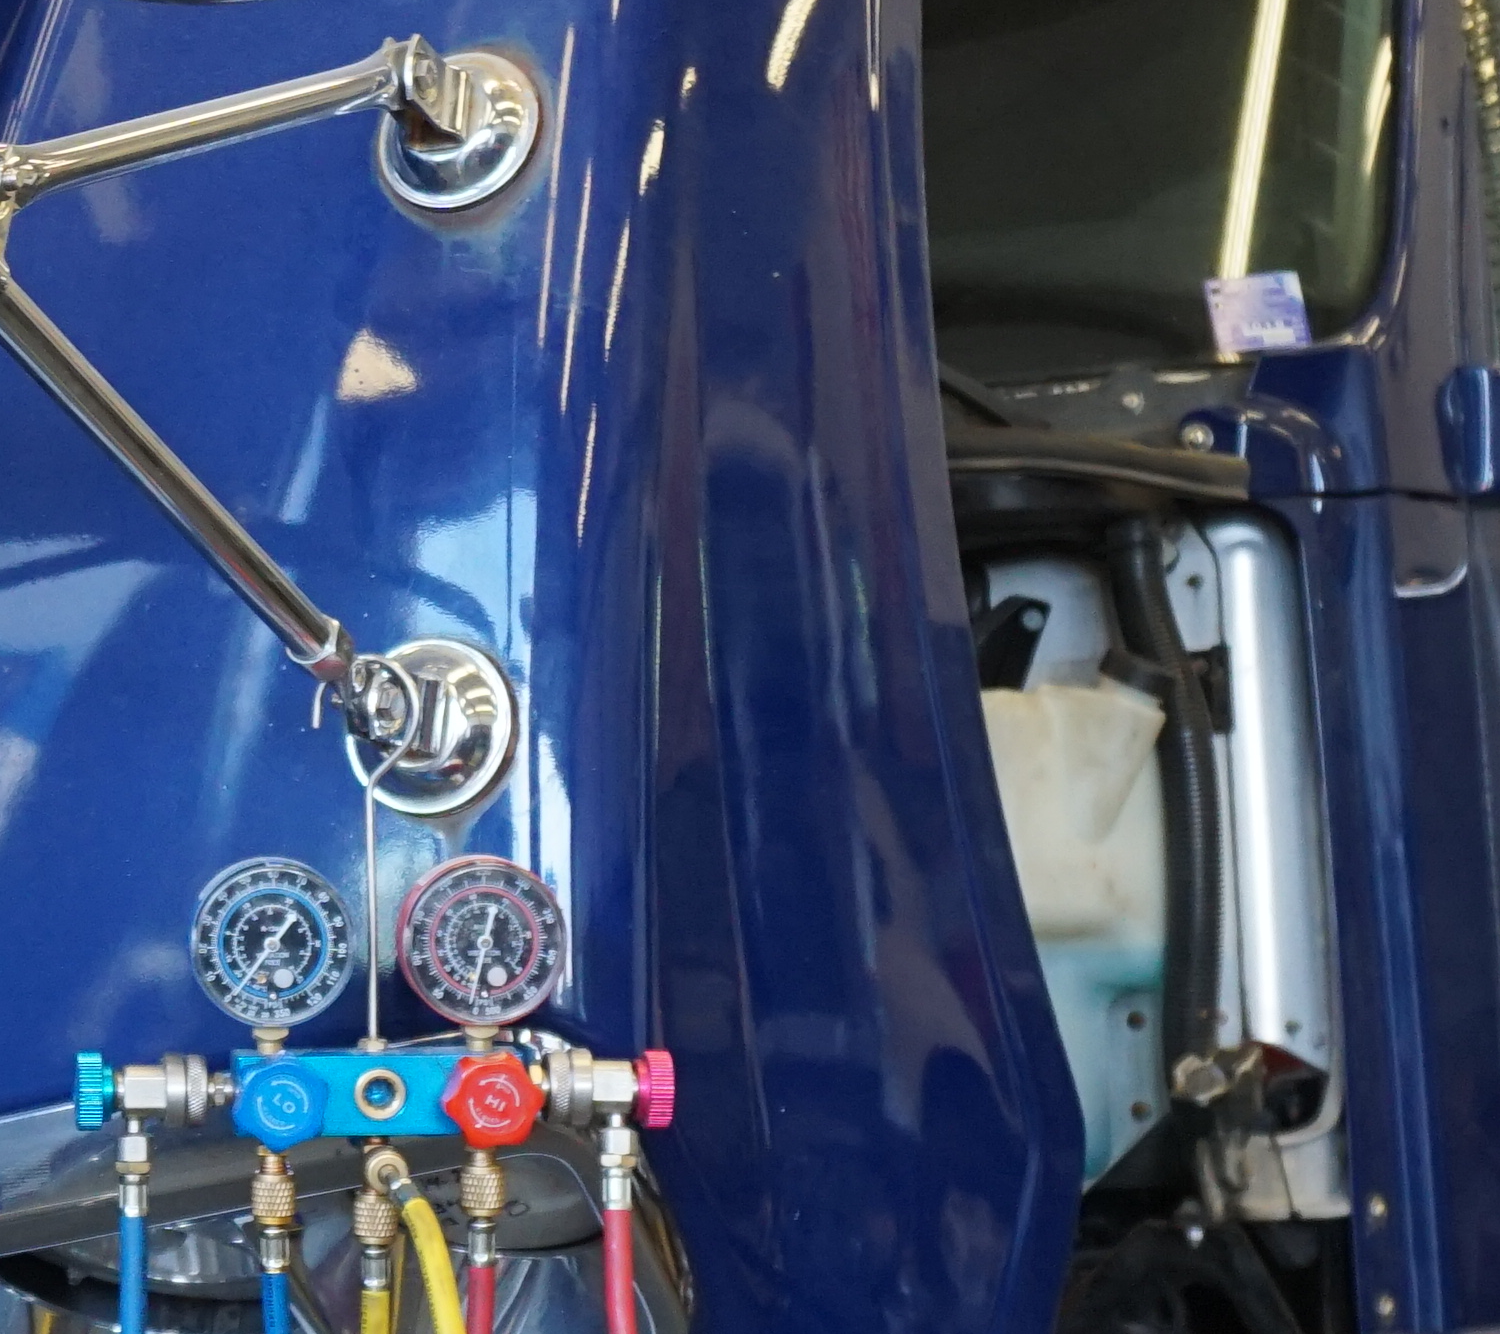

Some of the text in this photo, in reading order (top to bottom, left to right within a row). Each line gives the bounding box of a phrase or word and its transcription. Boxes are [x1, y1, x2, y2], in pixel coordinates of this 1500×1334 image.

[336, 942, 348, 958] 100
[272, 1092, 296, 1114] LO
[484, 1094, 508, 1113] HI
